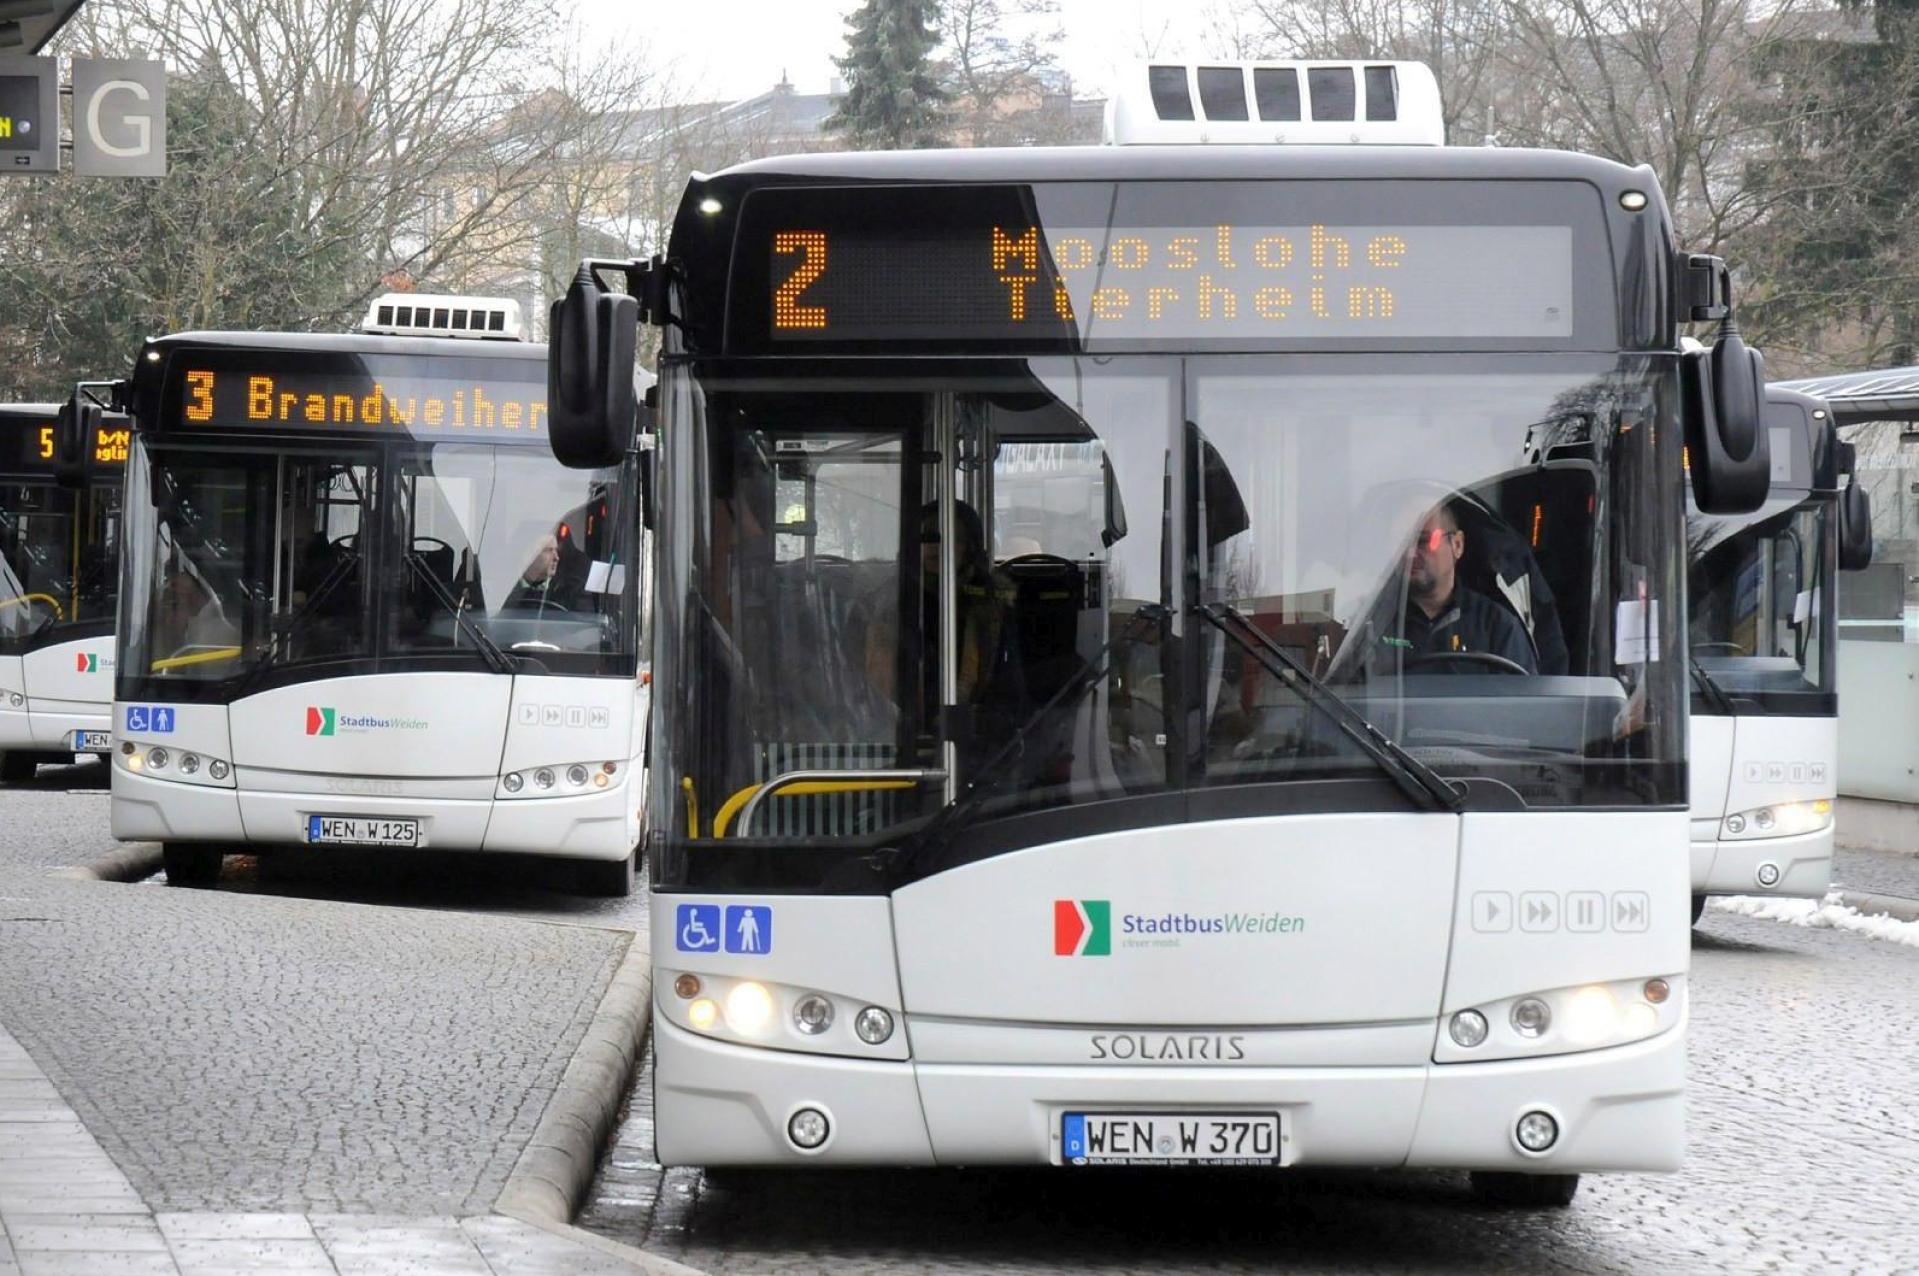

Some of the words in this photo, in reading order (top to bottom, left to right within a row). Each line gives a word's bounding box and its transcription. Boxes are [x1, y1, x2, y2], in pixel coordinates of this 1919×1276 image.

[87, 80, 151, 157] G
[993, 224, 1406, 270] Mooslohe
[772, 232, 827, 328] 2
[999, 274, 1394, 319] Tierheim
[187, 371, 214, 421] 3
[248, 376, 548, 430] Brandweiher
[40, 428, 54, 458] 5
[85, 733, 108, 746] WEN
[322, 820, 356, 838] WEN
[382, 823, 415, 841] 125
[1090, 1035, 1246, 1060] SOLARIS
[1086, 1121, 1154, 1153] WEN
[1209, 1122, 1272, 1155] 370
